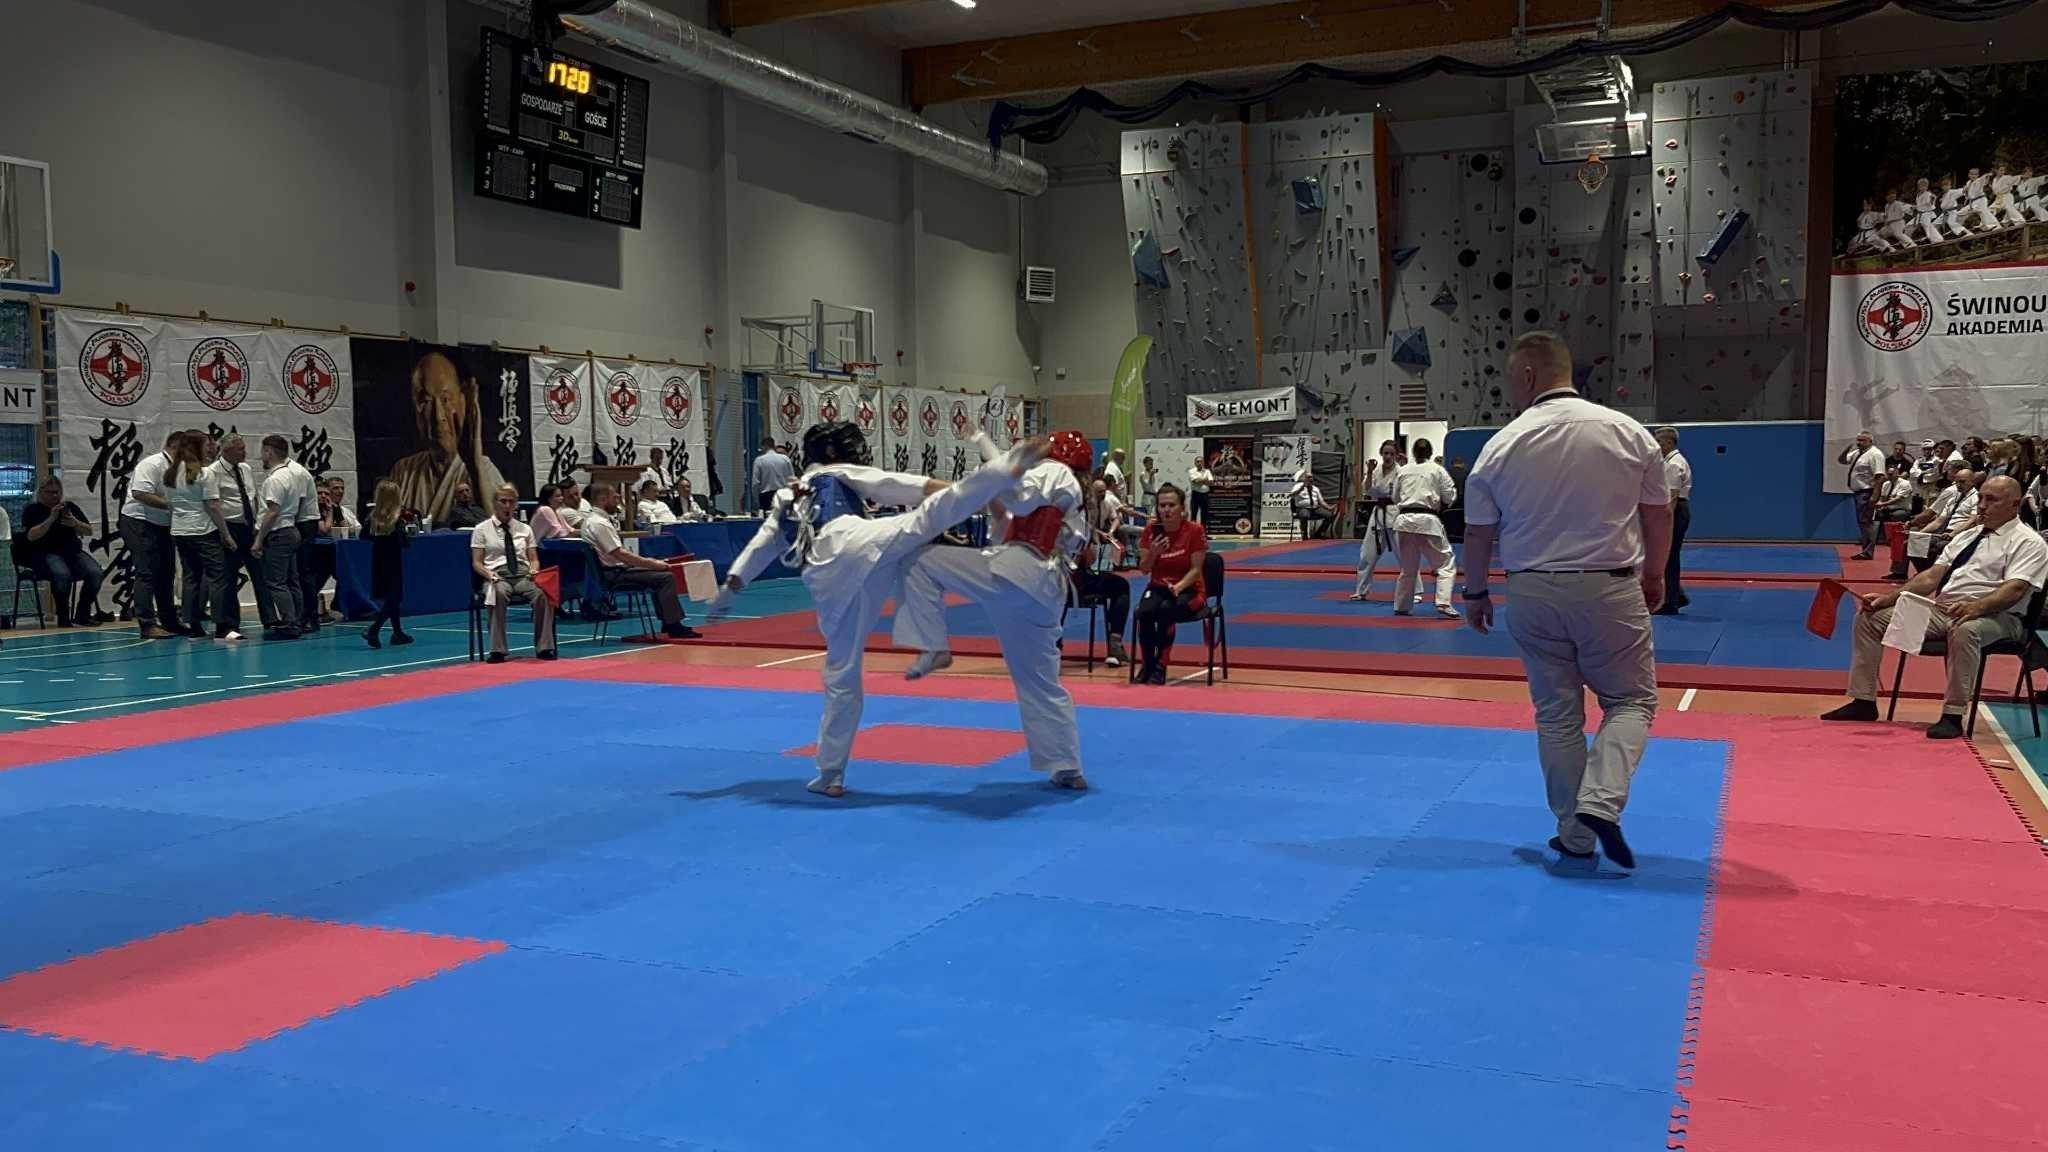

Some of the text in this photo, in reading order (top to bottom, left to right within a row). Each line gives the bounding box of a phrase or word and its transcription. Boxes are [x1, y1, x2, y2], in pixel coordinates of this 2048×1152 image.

[521, 92, 563, 116] GOSPODARZE
[584, 111, 608, 128] GOŚCIE
[1947, 293, 2047, 316] ŚWINOU
[1947, 319, 2044, 336] AKADEMIA
[4, 387, 36, 407] NT
[1217, 398, 1290, 417] REMONT
